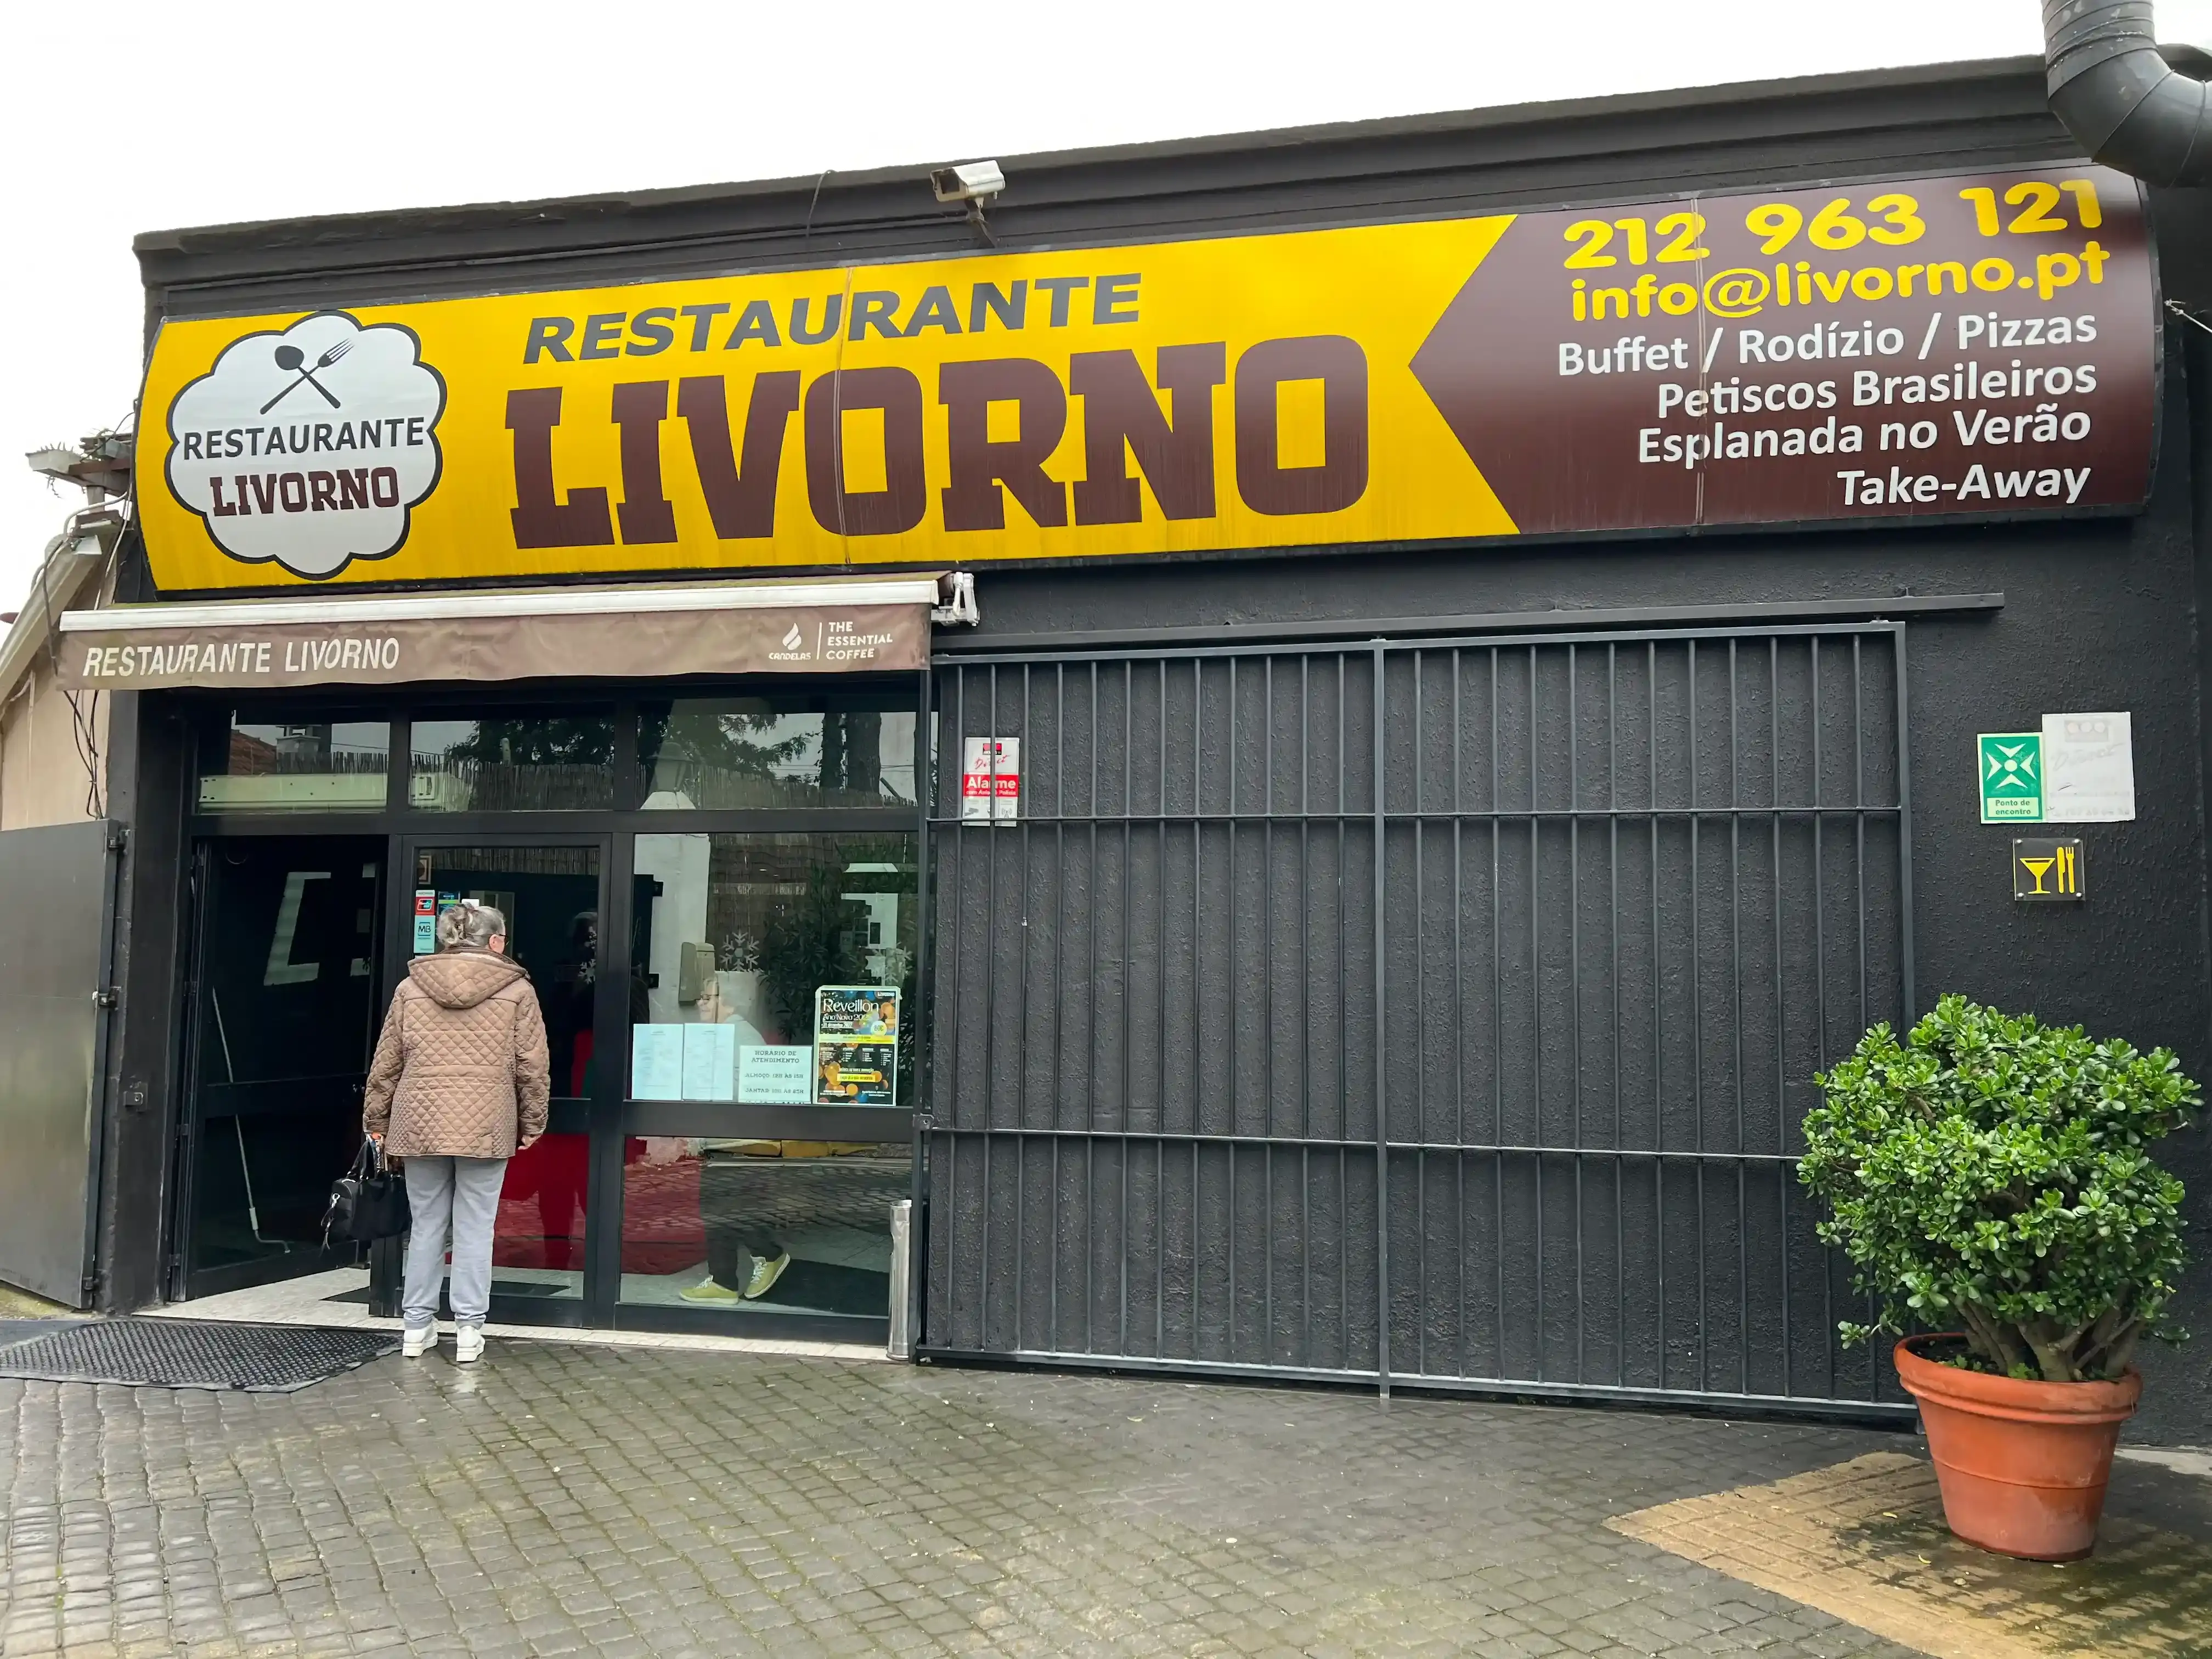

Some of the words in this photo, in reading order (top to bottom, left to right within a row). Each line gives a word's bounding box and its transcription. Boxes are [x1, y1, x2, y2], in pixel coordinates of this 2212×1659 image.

[1564, 212, 1710, 269] 212
[1746, 194, 1926, 255] 963
[1960, 179, 2102, 236] 121
[1572, 241, 2110, 321] info@livorno.pt
[523, 273, 1141, 364] RESTAURANTE
[1559, 336, 1689, 375] Buffet
[1702, 328, 1723, 373] /
[1739, 320, 1904, 364] Rodízio
[1918, 313, 1942, 360] /
[1959, 312, 2097, 349] Pizzas
[1659, 377, 1836, 418] Petiscos
[1853, 359, 2097, 406] Brasileiros
[183, 417, 424, 459] RESTAURANTE
[505, 335, 1369, 549] LIVORNO
[1639, 416, 1863, 470] Esplanada
[1880, 419, 1937, 450] no
[1953, 403, 2091, 446] Verão
[210, 466, 399, 516] LIVORNO
[1837, 464, 2091, 505] Take-Away
[827, 634, 893, 646] ESSENTIAL
[828, 621, 853, 632] THE
[83, 642, 272, 676] RESTAURANTE
[285, 637, 399, 672] LIVORNO
[826, 648, 874, 660] COFFEE
[966, 776, 1017, 789] Alame
